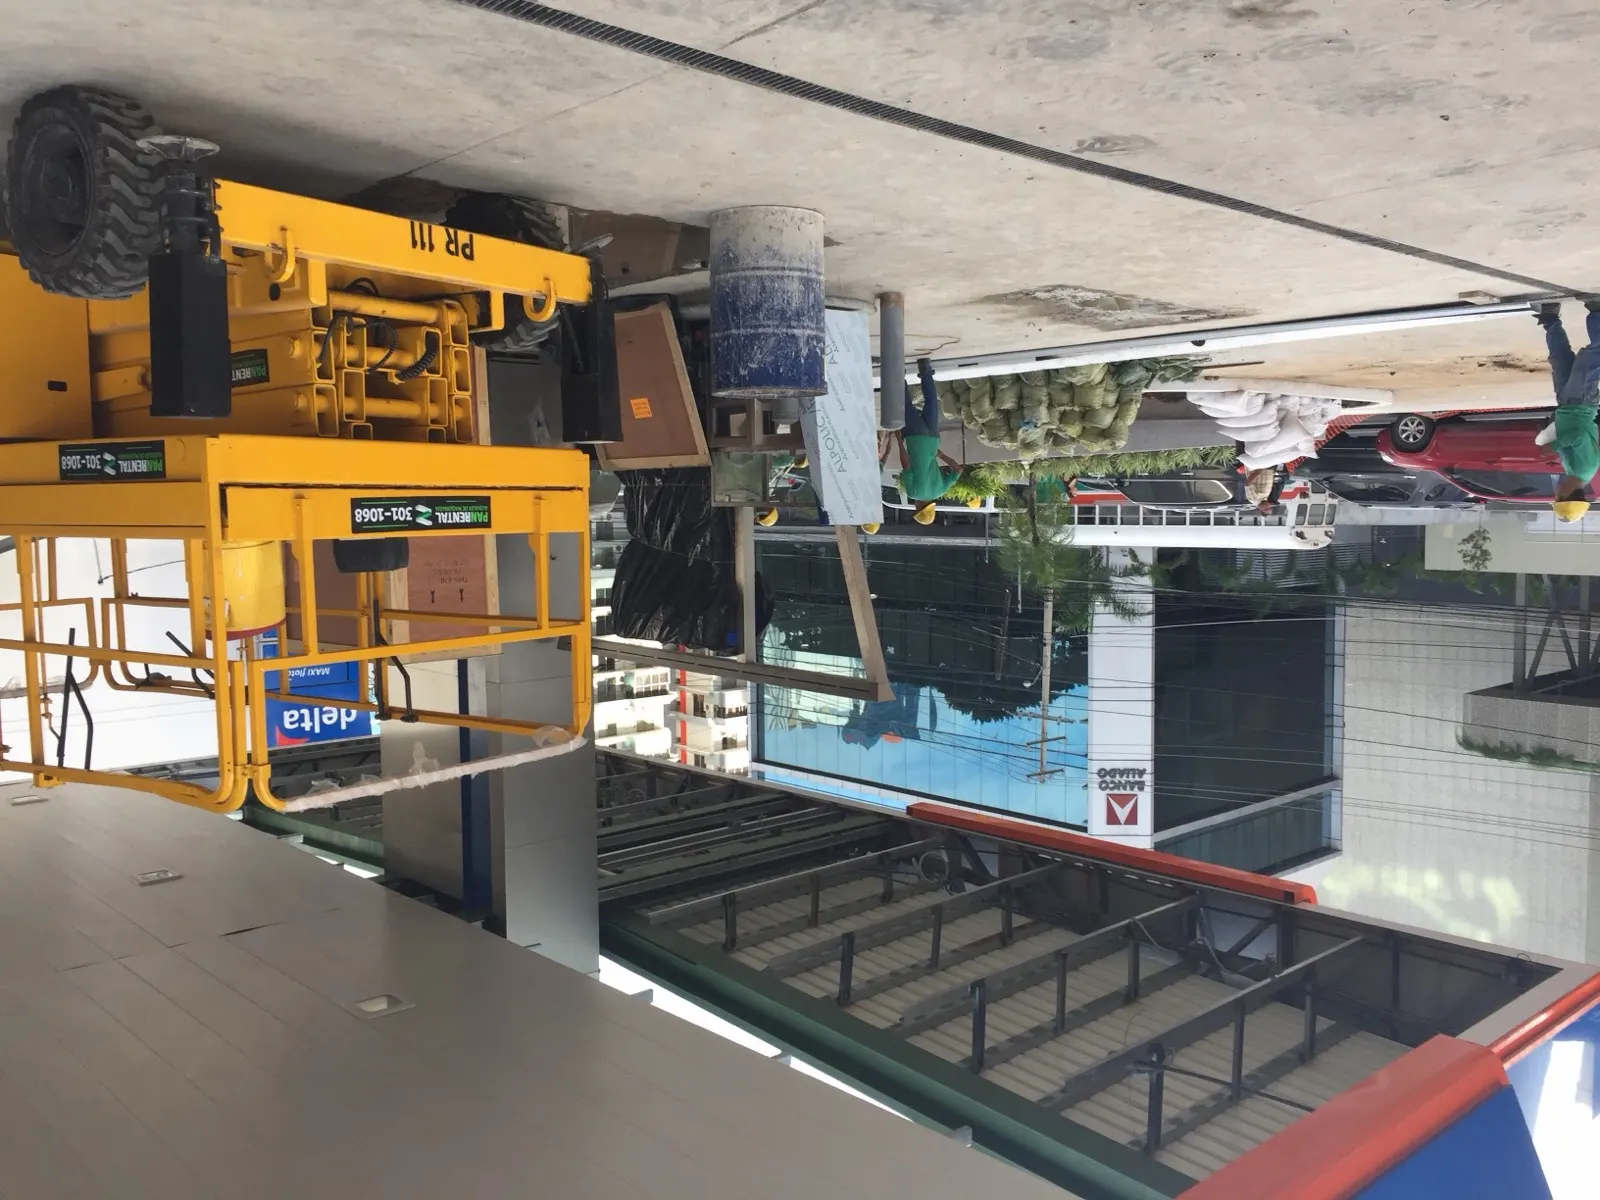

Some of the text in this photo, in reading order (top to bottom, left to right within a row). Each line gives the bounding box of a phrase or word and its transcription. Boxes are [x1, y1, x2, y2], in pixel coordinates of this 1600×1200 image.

[410, 221, 474, 261] PR 111
[816, 416, 846, 472] ALPOLIC
[62, 454, 162, 472] PANRENTAL 301-1068
[354, 506, 488, 524] PANRENTAL 301-1068
[308, 667, 330, 676] MAXI
[284, 706, 357, 733] delta
[1098, 768, 1146, 779] ALIADO
[1098, 780, 1145, 792] BANCO
